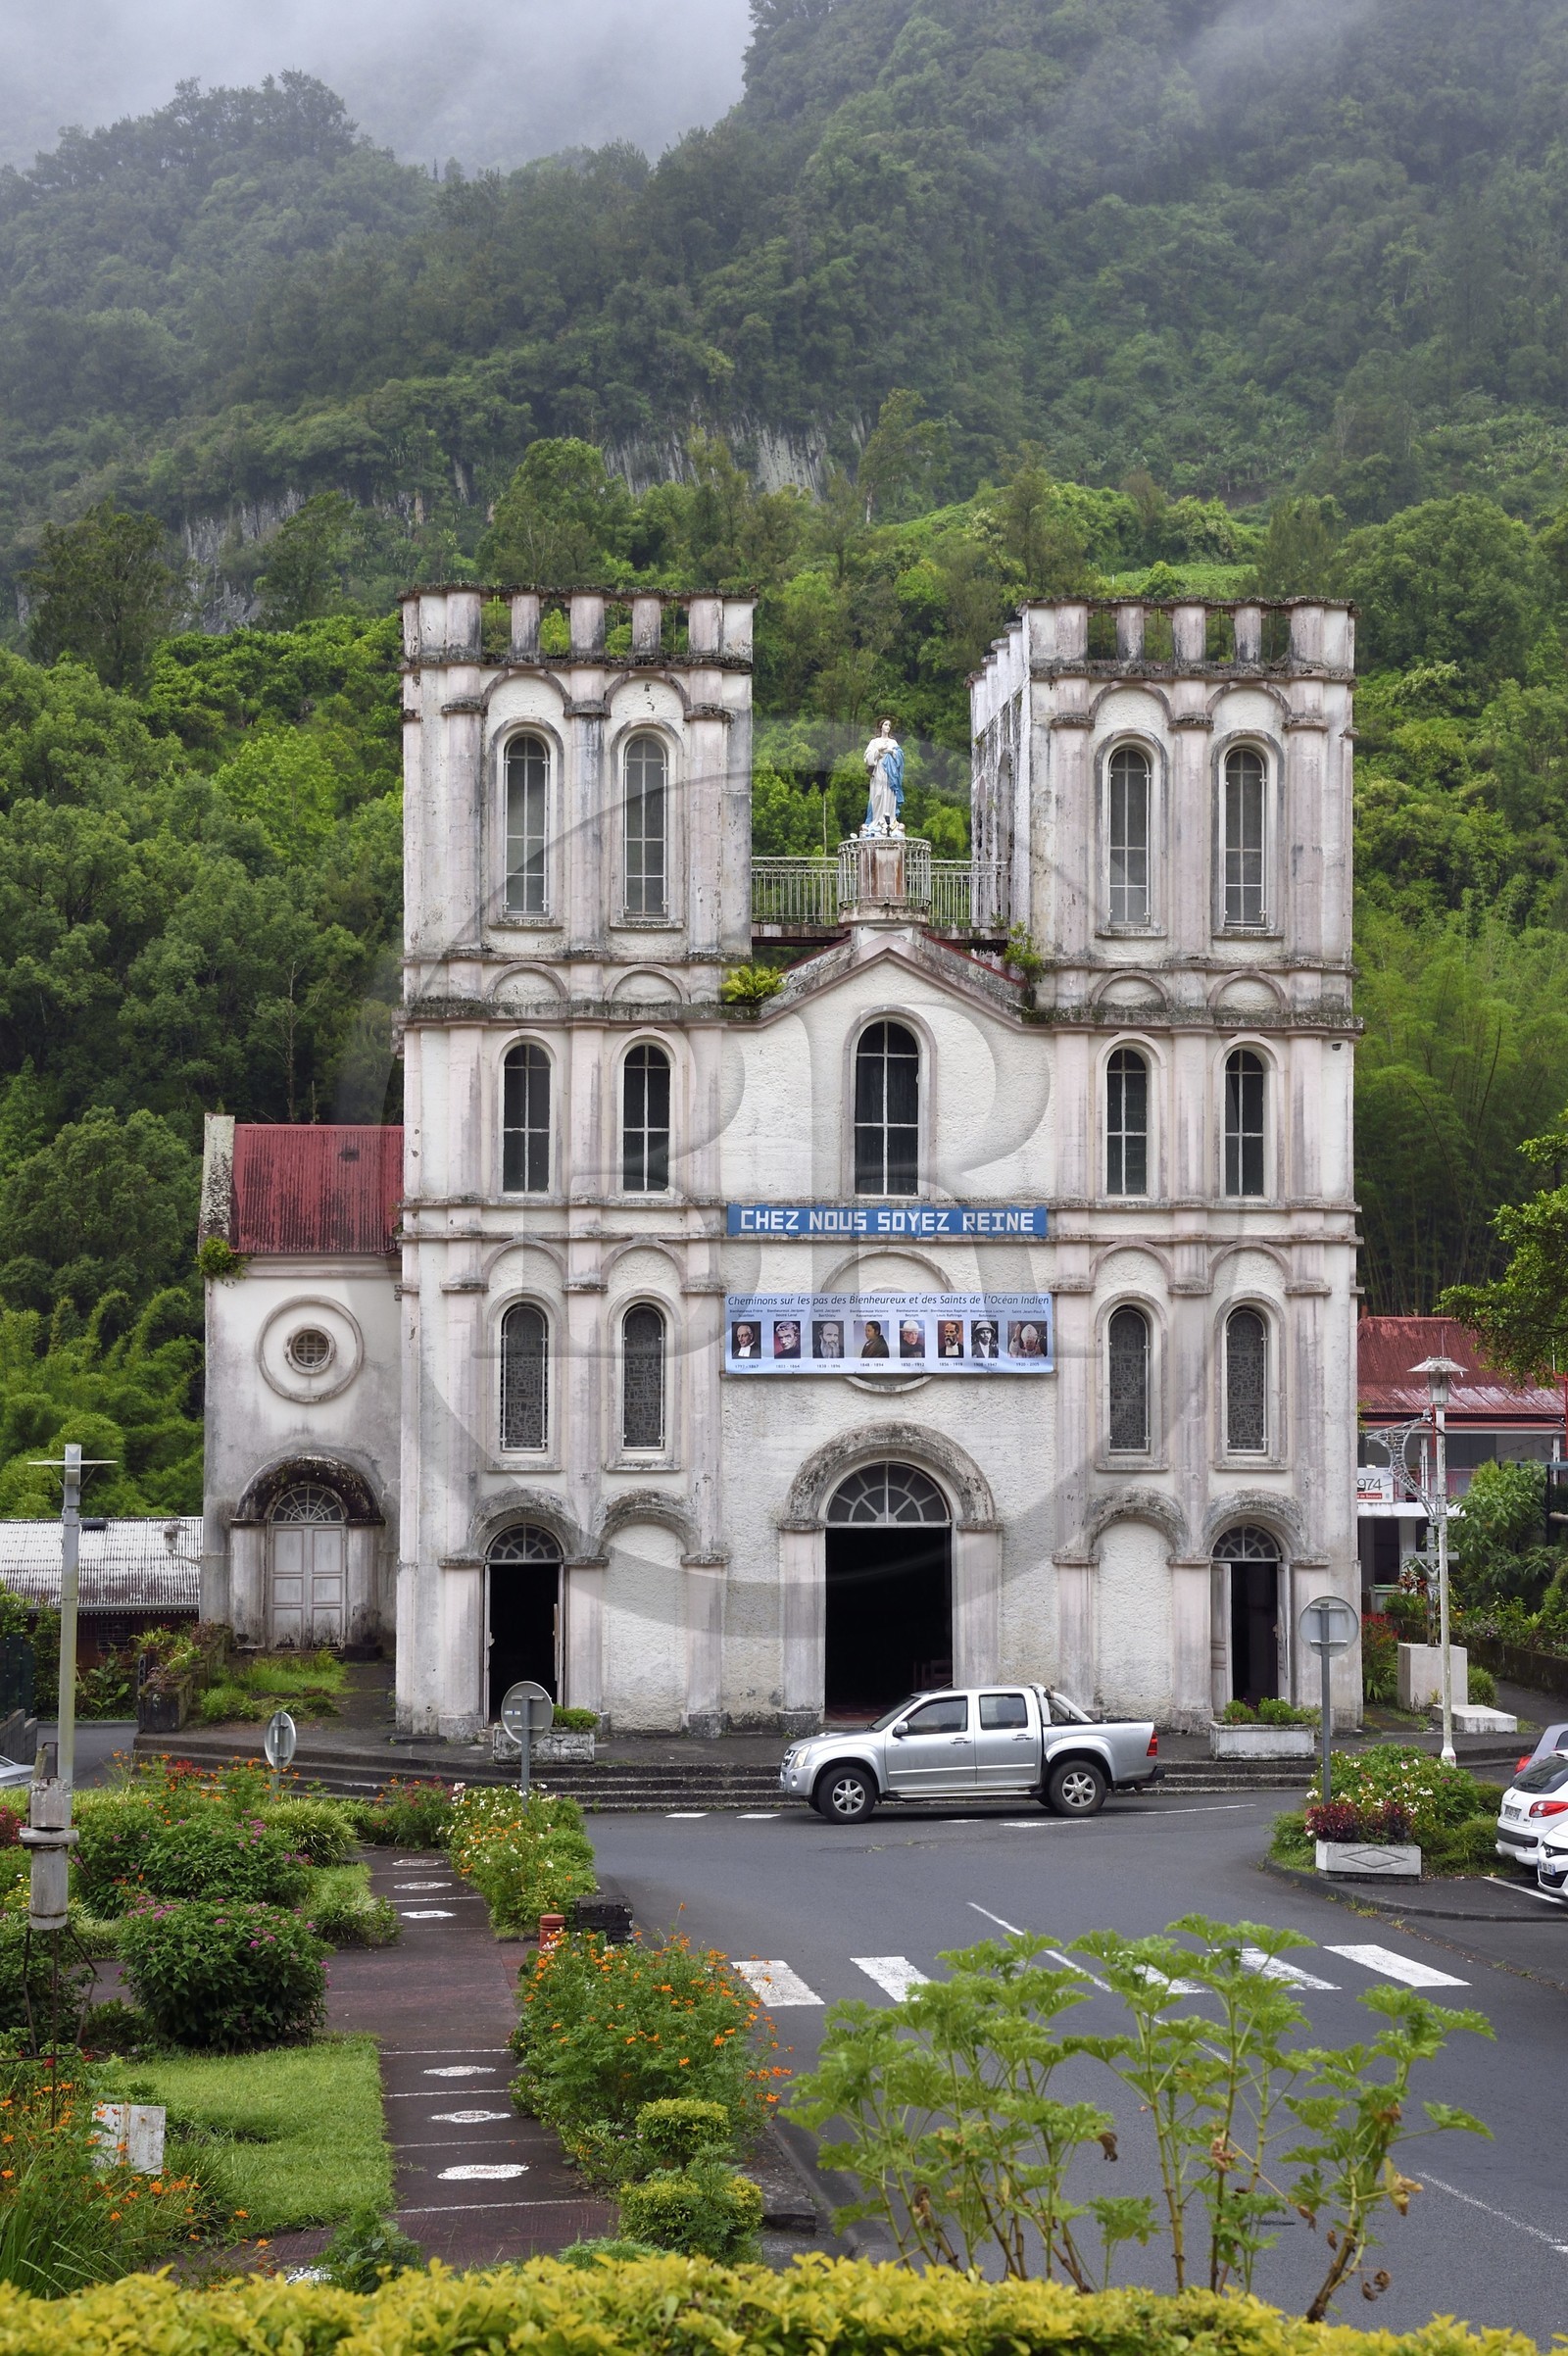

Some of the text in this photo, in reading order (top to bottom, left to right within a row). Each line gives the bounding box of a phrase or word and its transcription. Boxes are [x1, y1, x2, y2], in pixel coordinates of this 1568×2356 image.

[741, 1210, 1034, 1232] CHEZ NOUS SOYEZ REINE
[728, 1297, 777, 1305] Cheminons
[812, 1298, 828, 1306] pas
[831, 1296, 847, 1304] des
[850, 1296, 906, 1304] Bienheureux
[984, 1296, 1018, 1304] l'Océan
[1021, 1296, 1050, 1304] Indien
